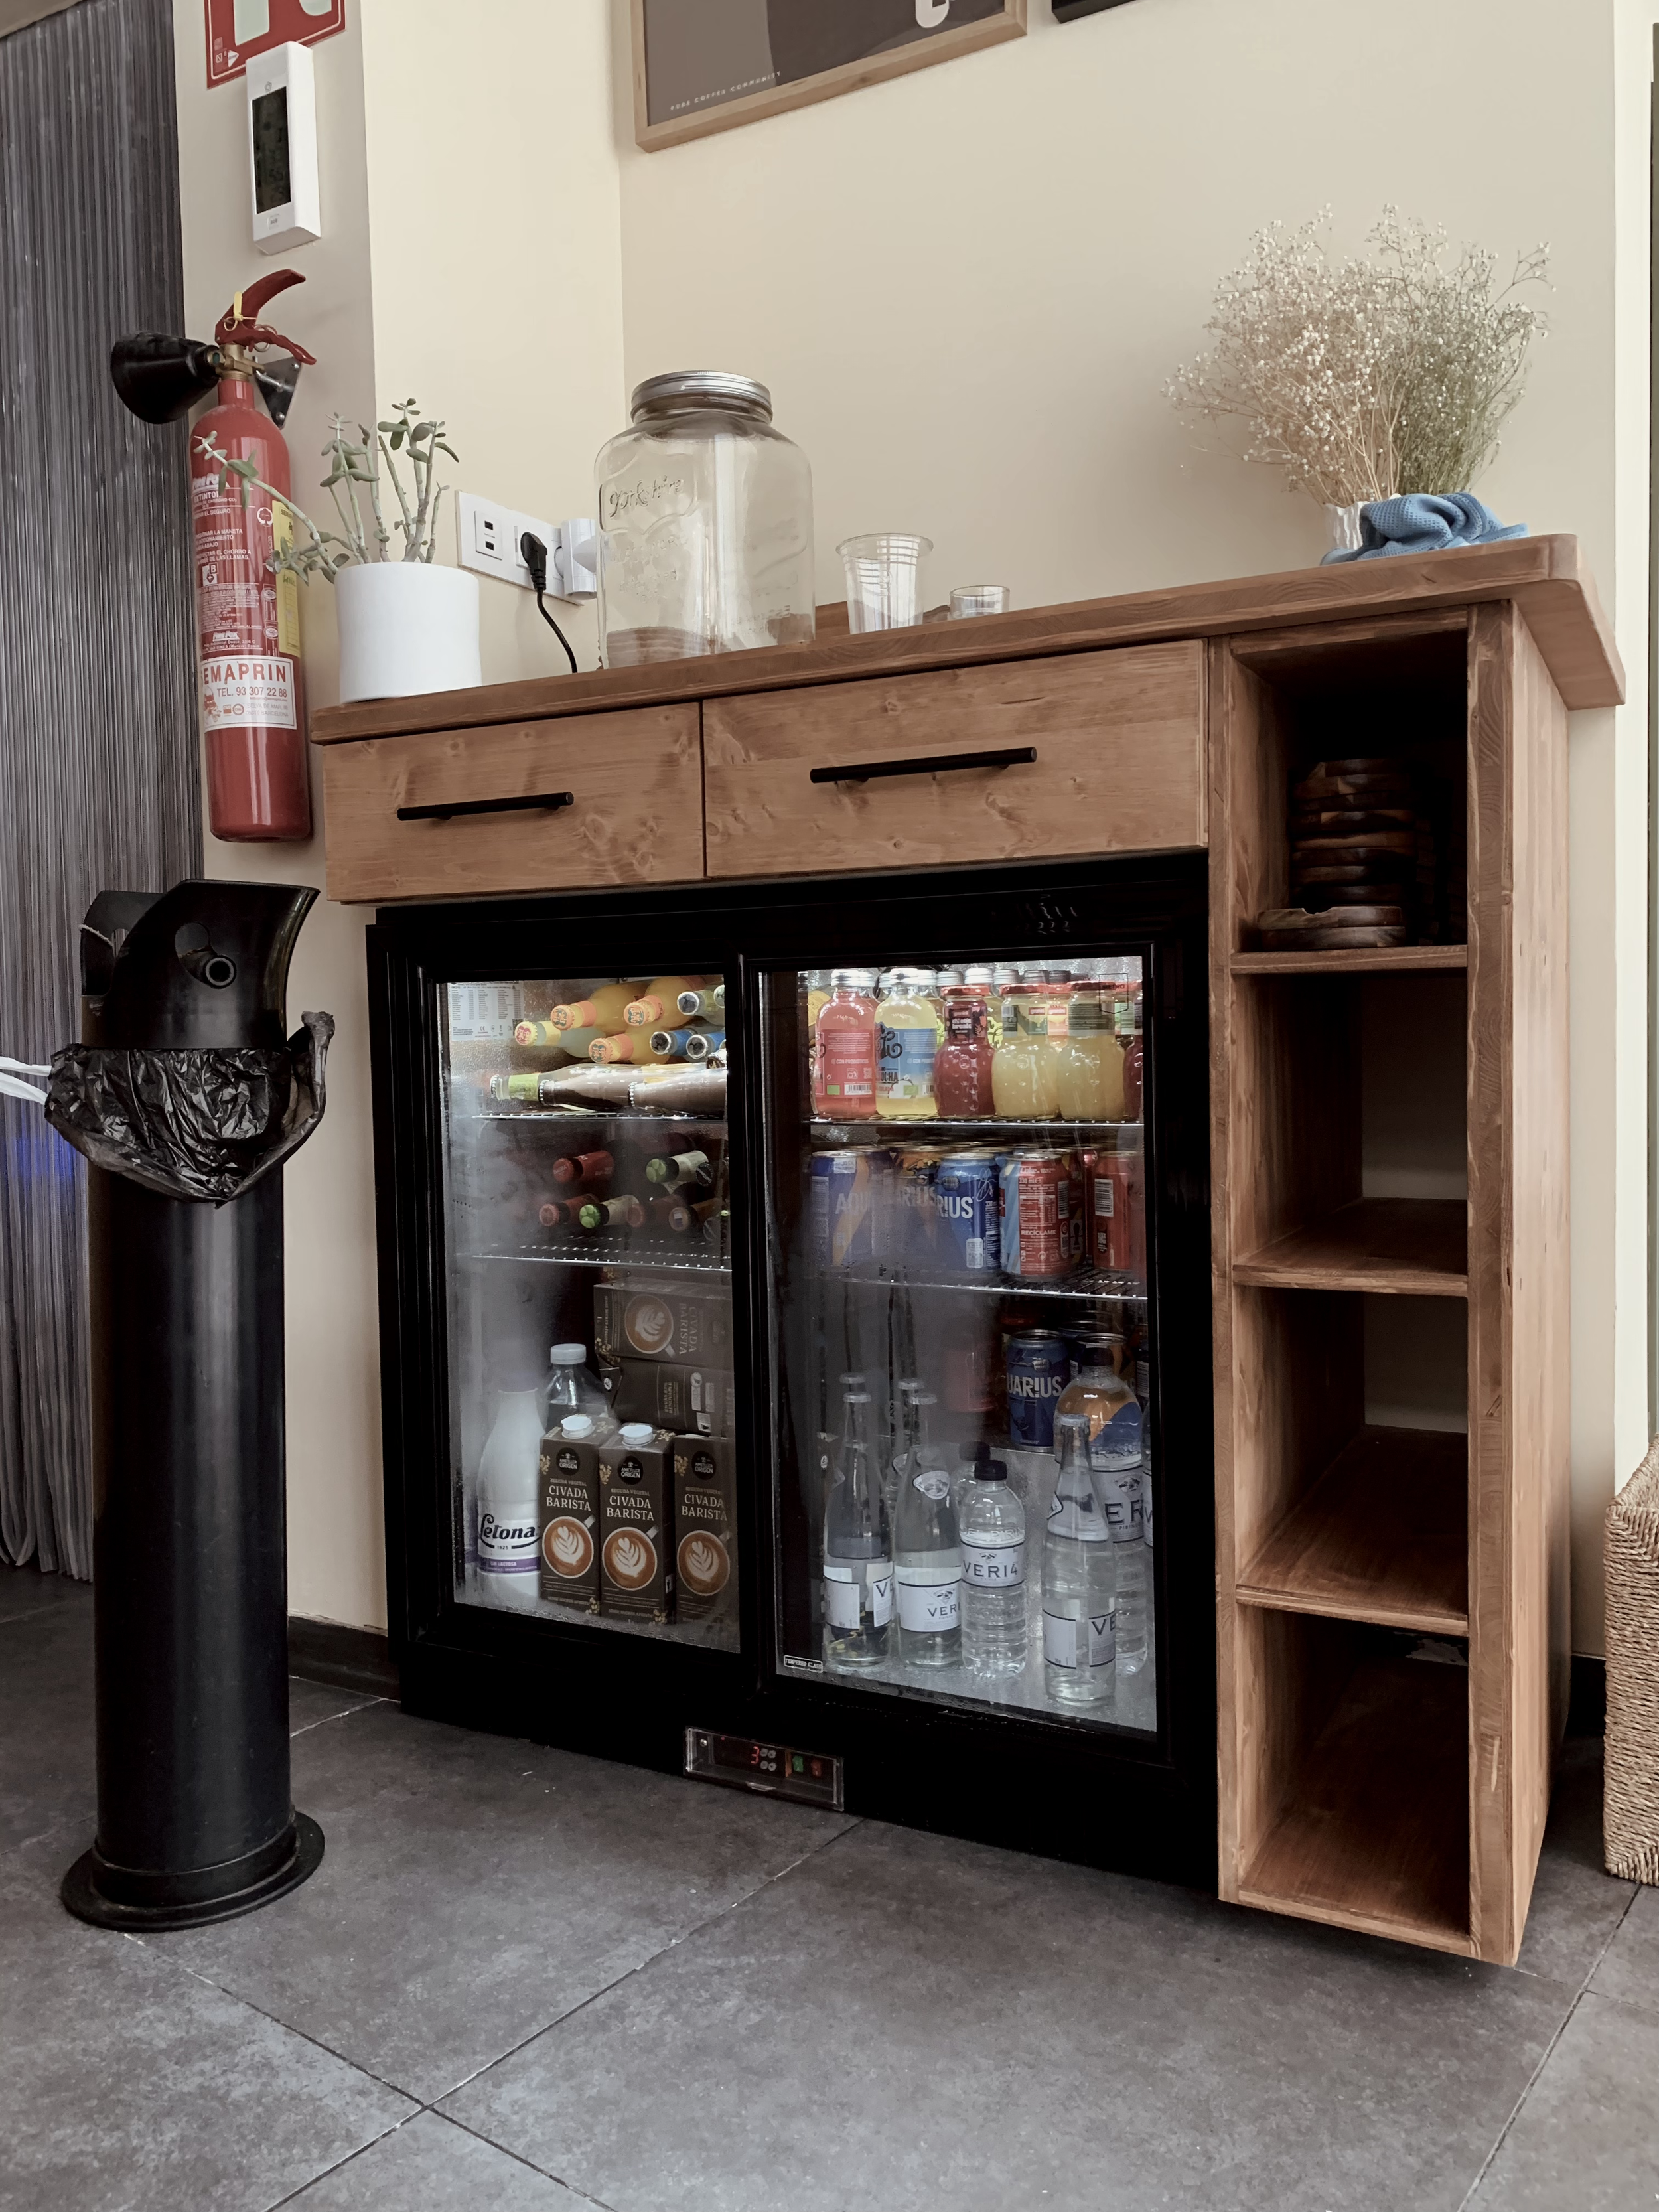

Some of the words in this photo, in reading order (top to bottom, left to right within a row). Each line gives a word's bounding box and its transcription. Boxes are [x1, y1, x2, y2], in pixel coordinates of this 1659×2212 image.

[731, 71, 781, 92] COMMUNITY
[202, 663, 286, 685] EMAPRIN
[217, 688, 234, 697] TEL.
[236, 686, 246, 696] 93
[249, 686, 264, 696] 307
[267, 687, 277, 697] 22
[279, 688, 287, 698] 88
[679, 1303, 689, 1355] BARISTA
[689, 1307, 697, 1352] CIVADA
[549, 1485, 588, 1499] CIVADA
[546, 1496, 591, 1512] BARISTA
[609, 1495, 652, 1509] CIVADA
[684, 1493, 725, 1509] CIVADA
[606, 1507, 655, 1522] BARISTA
[682, 1505, 728, 1522] BARISTA
[480, 1513, 536, 1540] Letona
[926, 1601, 960, 1617] VERI
